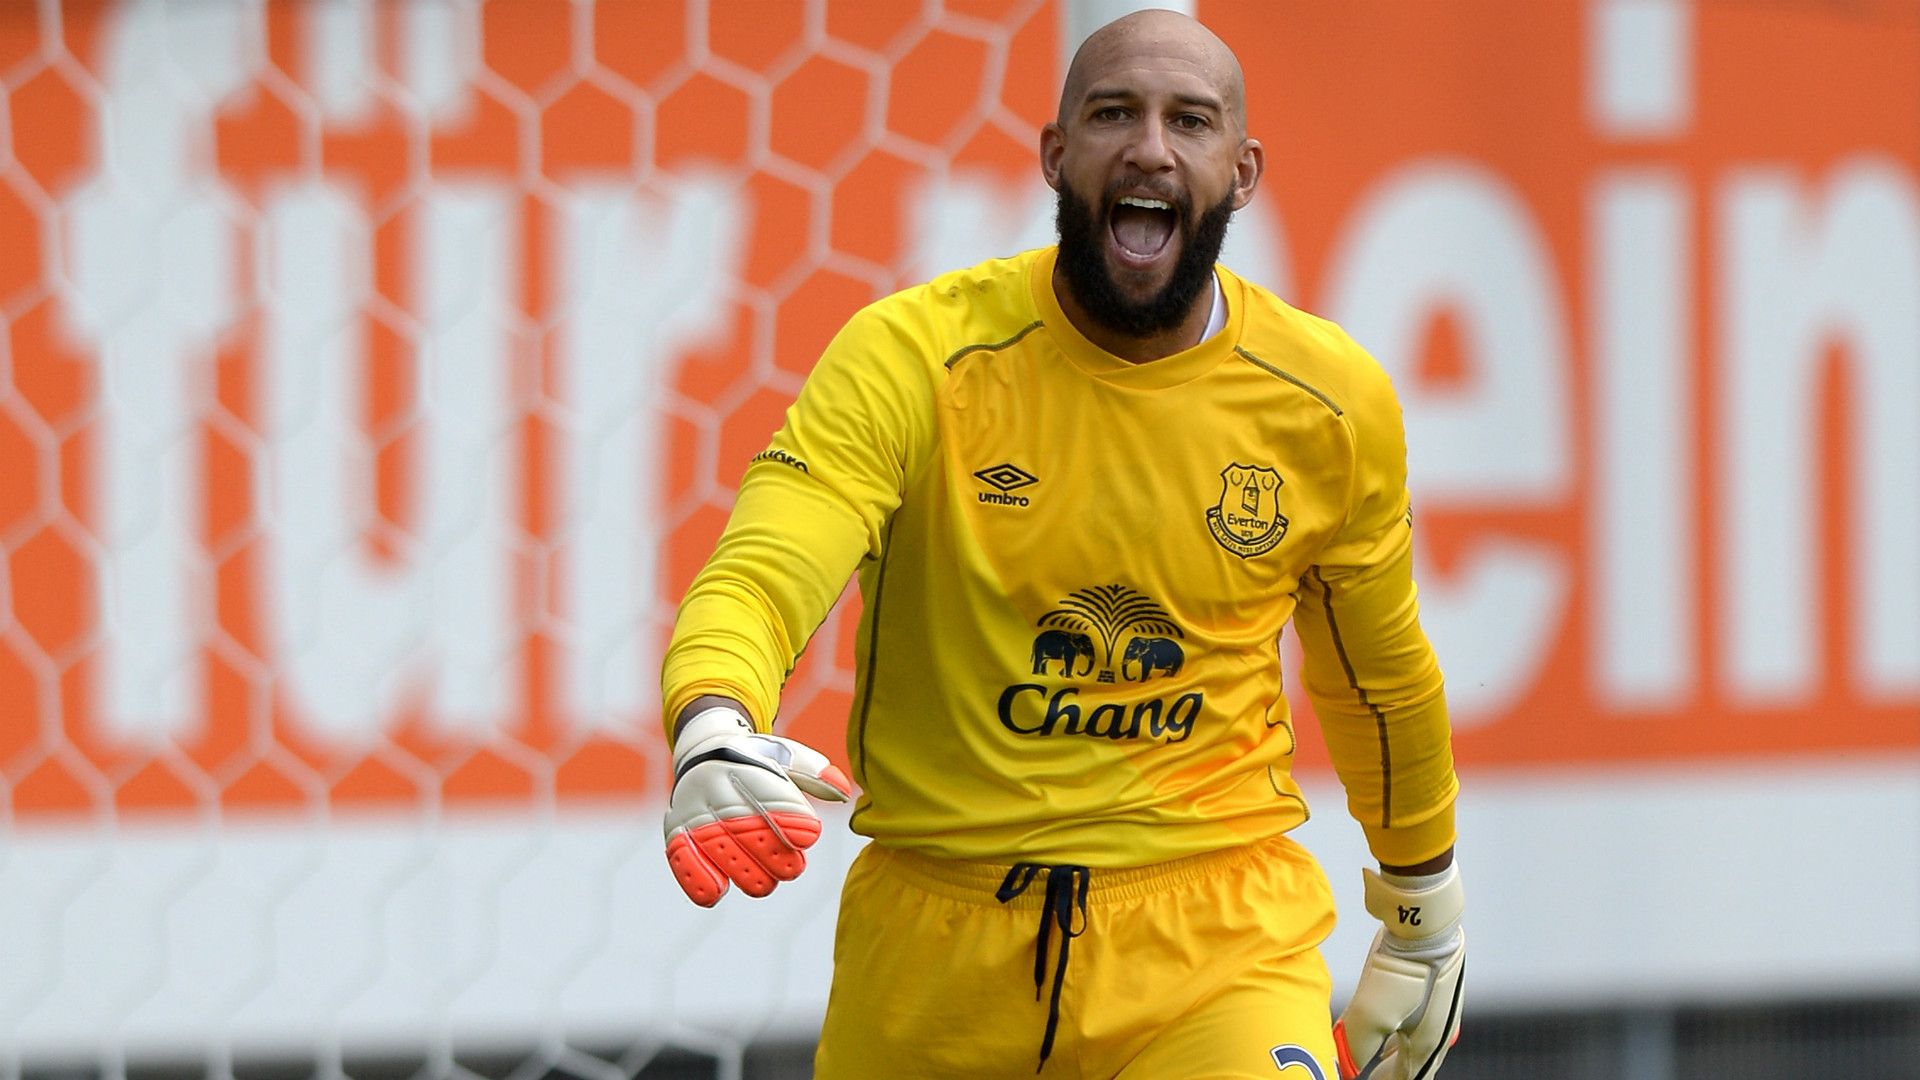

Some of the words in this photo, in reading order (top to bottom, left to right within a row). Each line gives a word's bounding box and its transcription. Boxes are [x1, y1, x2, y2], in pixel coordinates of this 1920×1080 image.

[60, 0, 748, 750] für
[908, 0, 1920, 730] ein
[978, 492, 1030, 507] umbro
[1227, 513, 1269, 530] Everton
[997, 683, 1204, 744] Chang
[1397, 904, 1422, 926] 24
